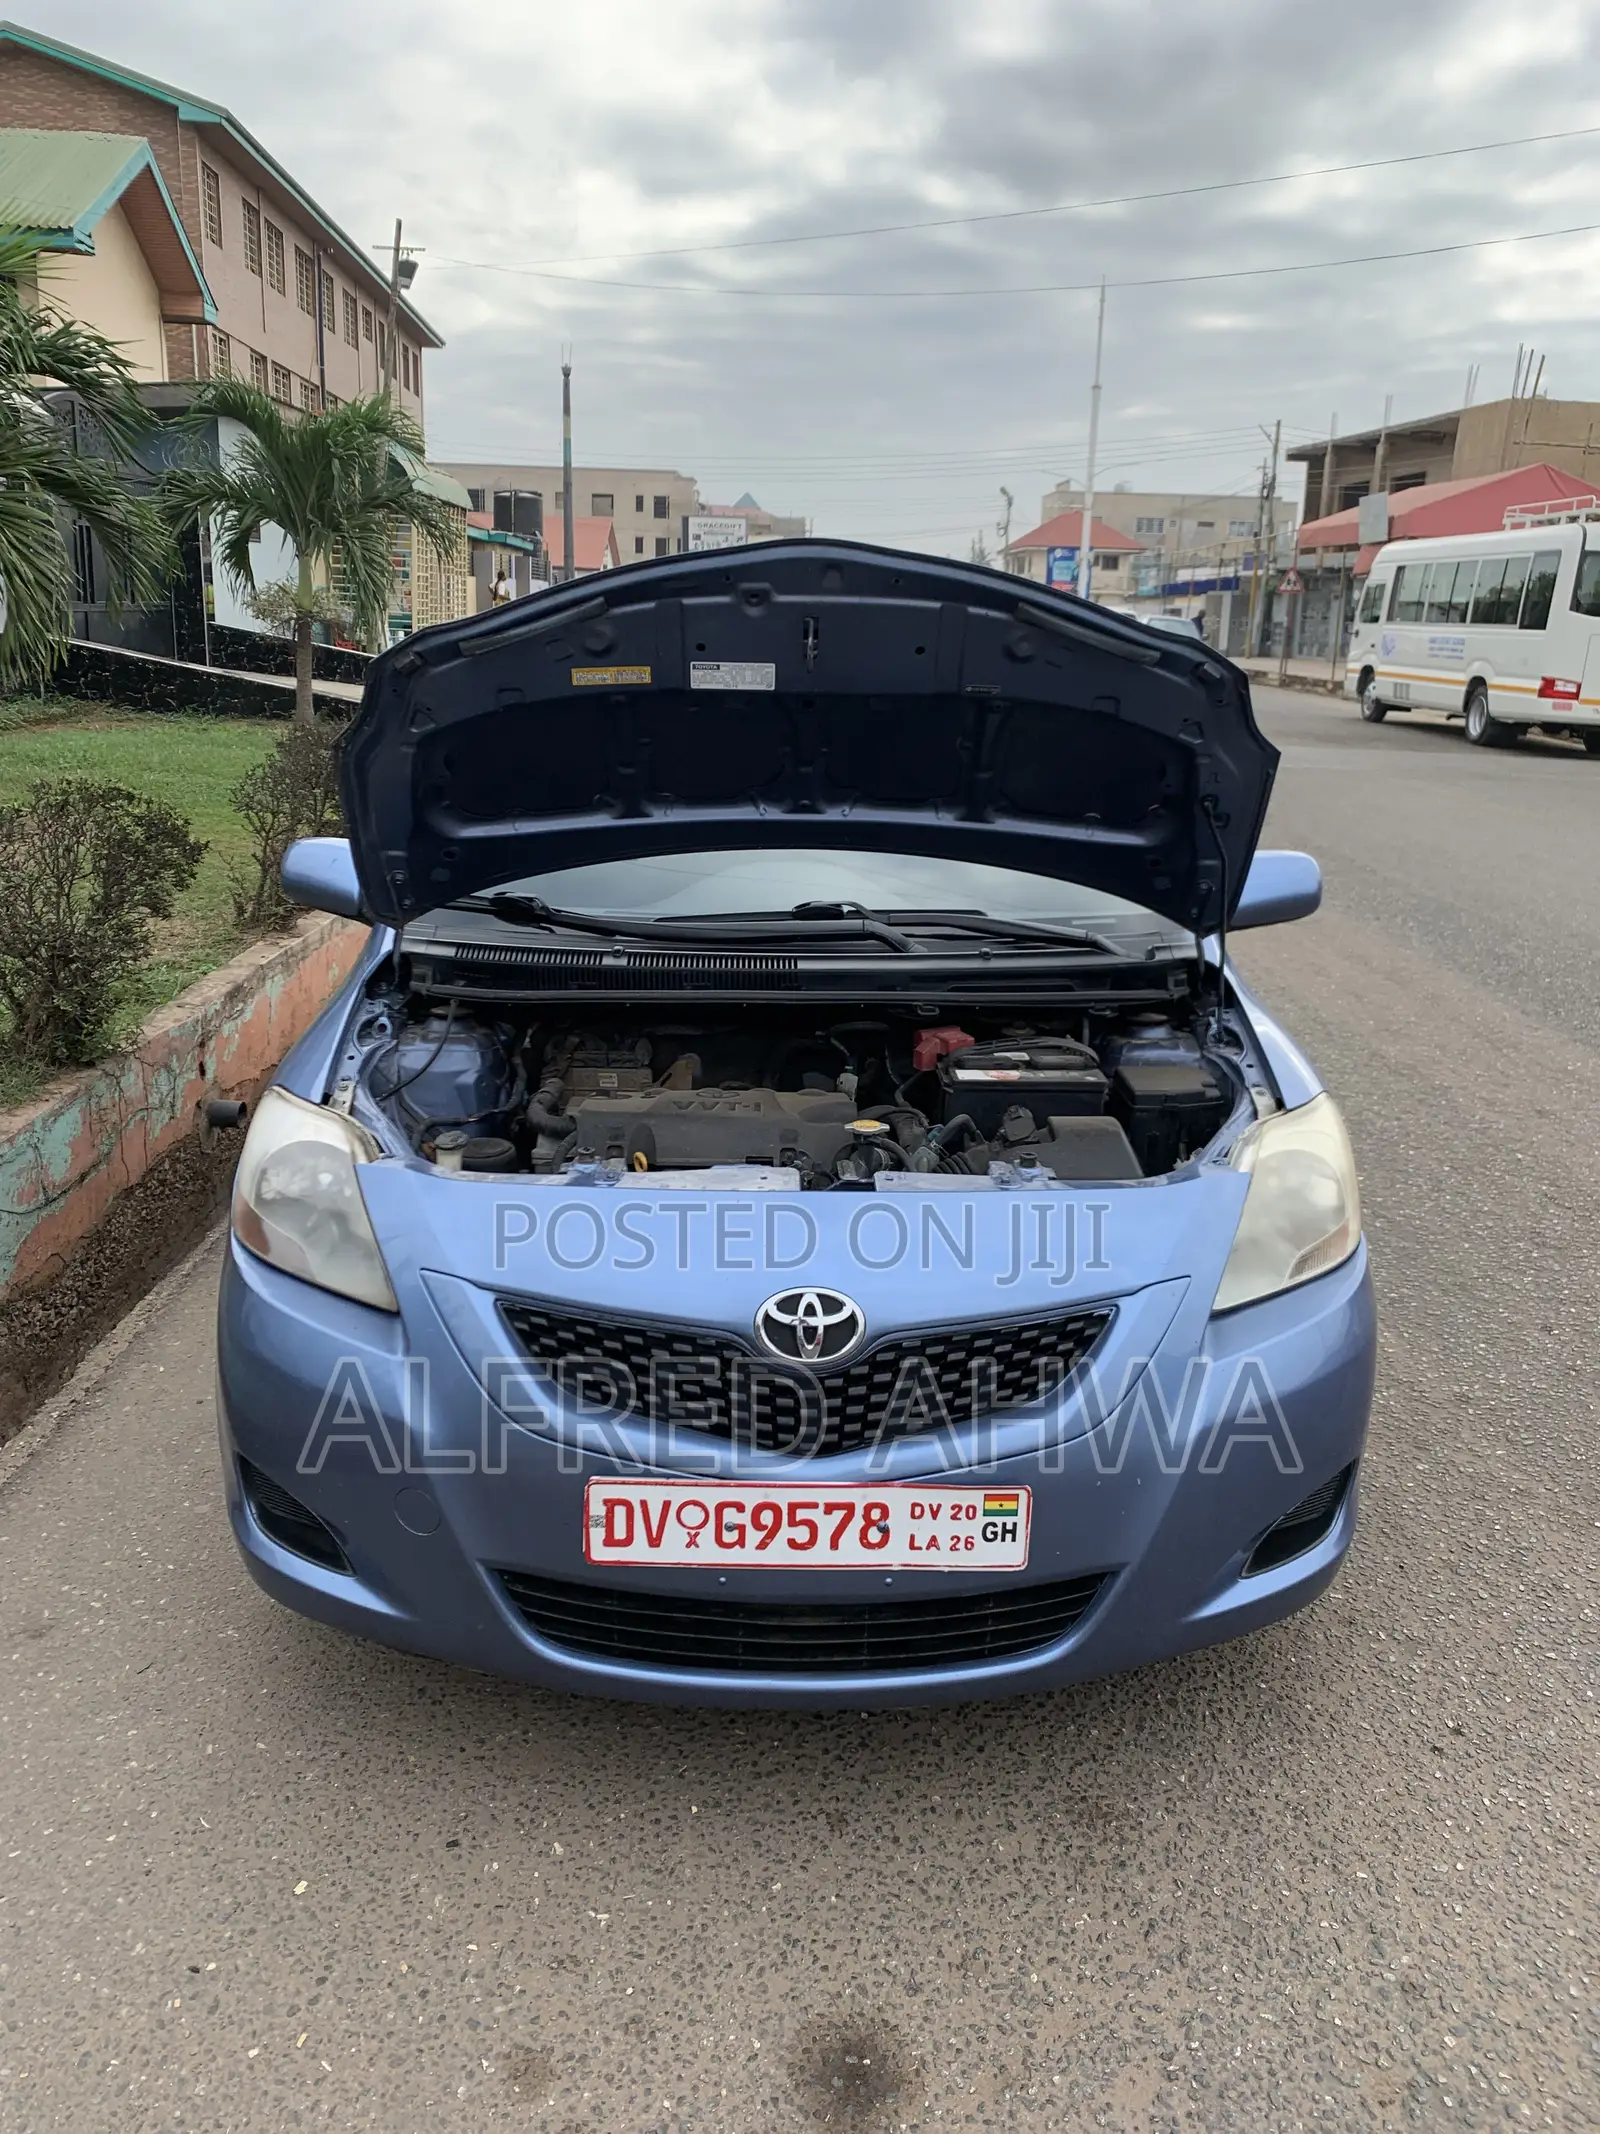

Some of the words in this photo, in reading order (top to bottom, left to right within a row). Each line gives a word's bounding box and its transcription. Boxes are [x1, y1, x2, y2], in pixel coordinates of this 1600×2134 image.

[910, 1502, 942, 1520] DV
[950, 1504, 977, 1520] 20
[714, 1500, 890, 1551] G9578
[981, 1521, 1017, 1543] GH
[909, 1533, 940, 1551] LA
[949, 1535, 975, 1551] 26
